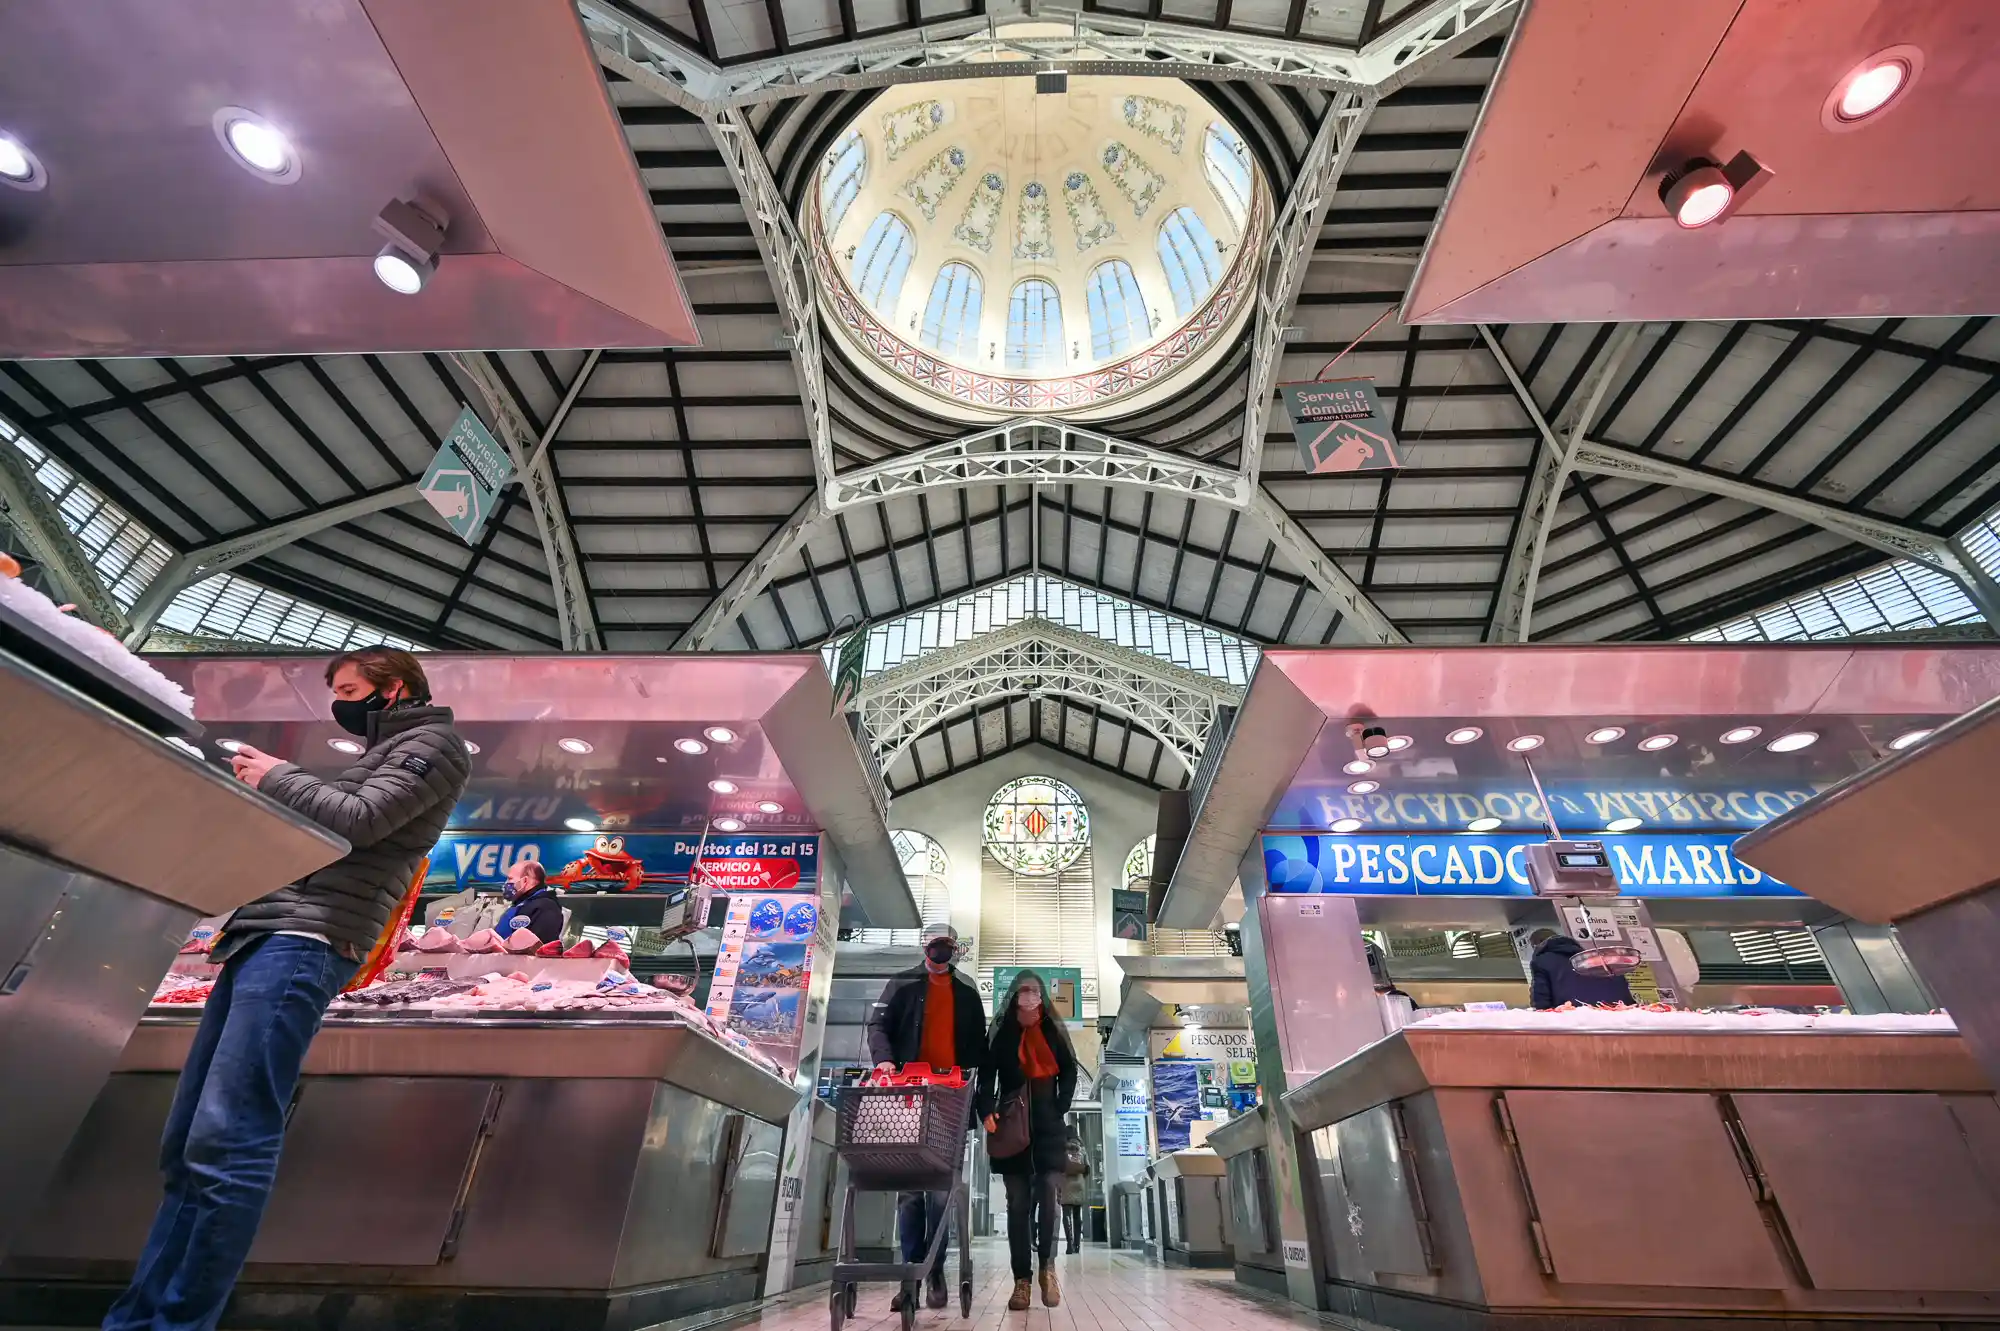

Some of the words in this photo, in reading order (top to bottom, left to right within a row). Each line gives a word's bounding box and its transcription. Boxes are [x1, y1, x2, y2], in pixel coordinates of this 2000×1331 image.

[1297, 389, 1350, 403] Servei
[1355, 390, 1365, 399] a
[1301, 400, 1371, 416] domicili
[460, 418, 499, 470] Servicio
[498, 468, 505, 480] a
[455, 435, 498, 489] domicilio
[735, 842, 759, 856] del
[763, 843, 776, 855] 12
[781, 842, 796, 855] al
[800, 843, 814, 856] 15
[753, 862, 761, 872] A
[1331, 844, 1531, 885] PESCADO
[1575, 916, 1608, 924] Clchina
[1191, 1034, 1247, 1046] PESCADOS
